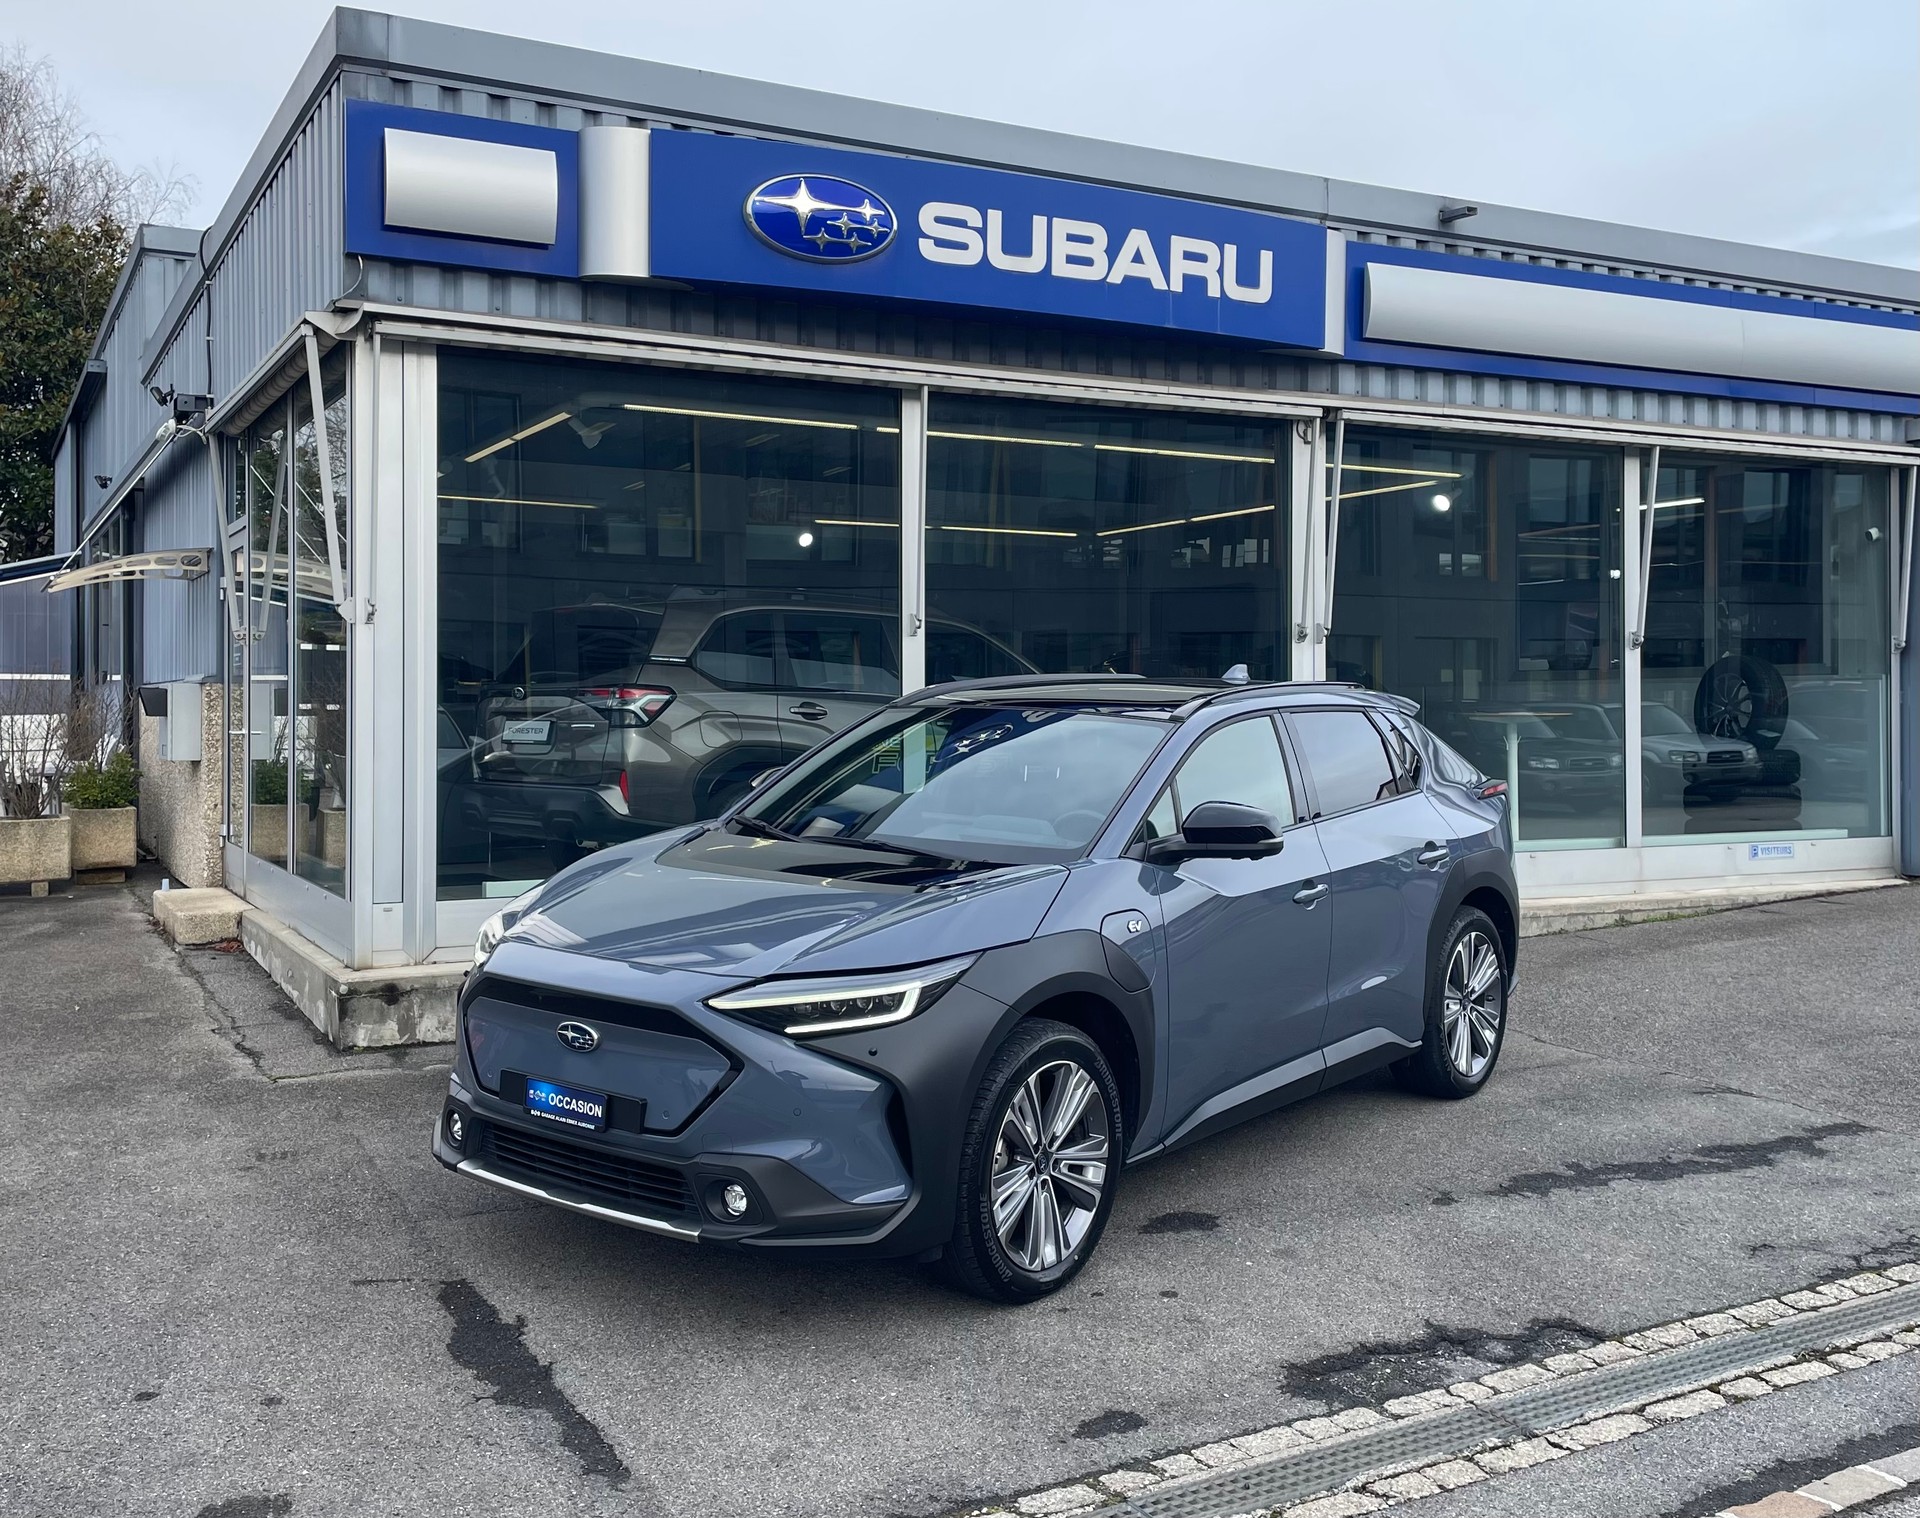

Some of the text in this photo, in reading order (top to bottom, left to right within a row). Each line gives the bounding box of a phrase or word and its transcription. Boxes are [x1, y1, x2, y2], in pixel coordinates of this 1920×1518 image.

[918, 201, 1274, 304] SUBARU
[1760, 846, 1792, 855] VISITEURS
[1128, 920, 1142, 932] EV
[548, 1093, 602, 1118] OCCASION
[1094, 1056, 1122, 1141] BRIDGESTONE
[980, 1193, 1013, 1282] BRIDGESTONE
